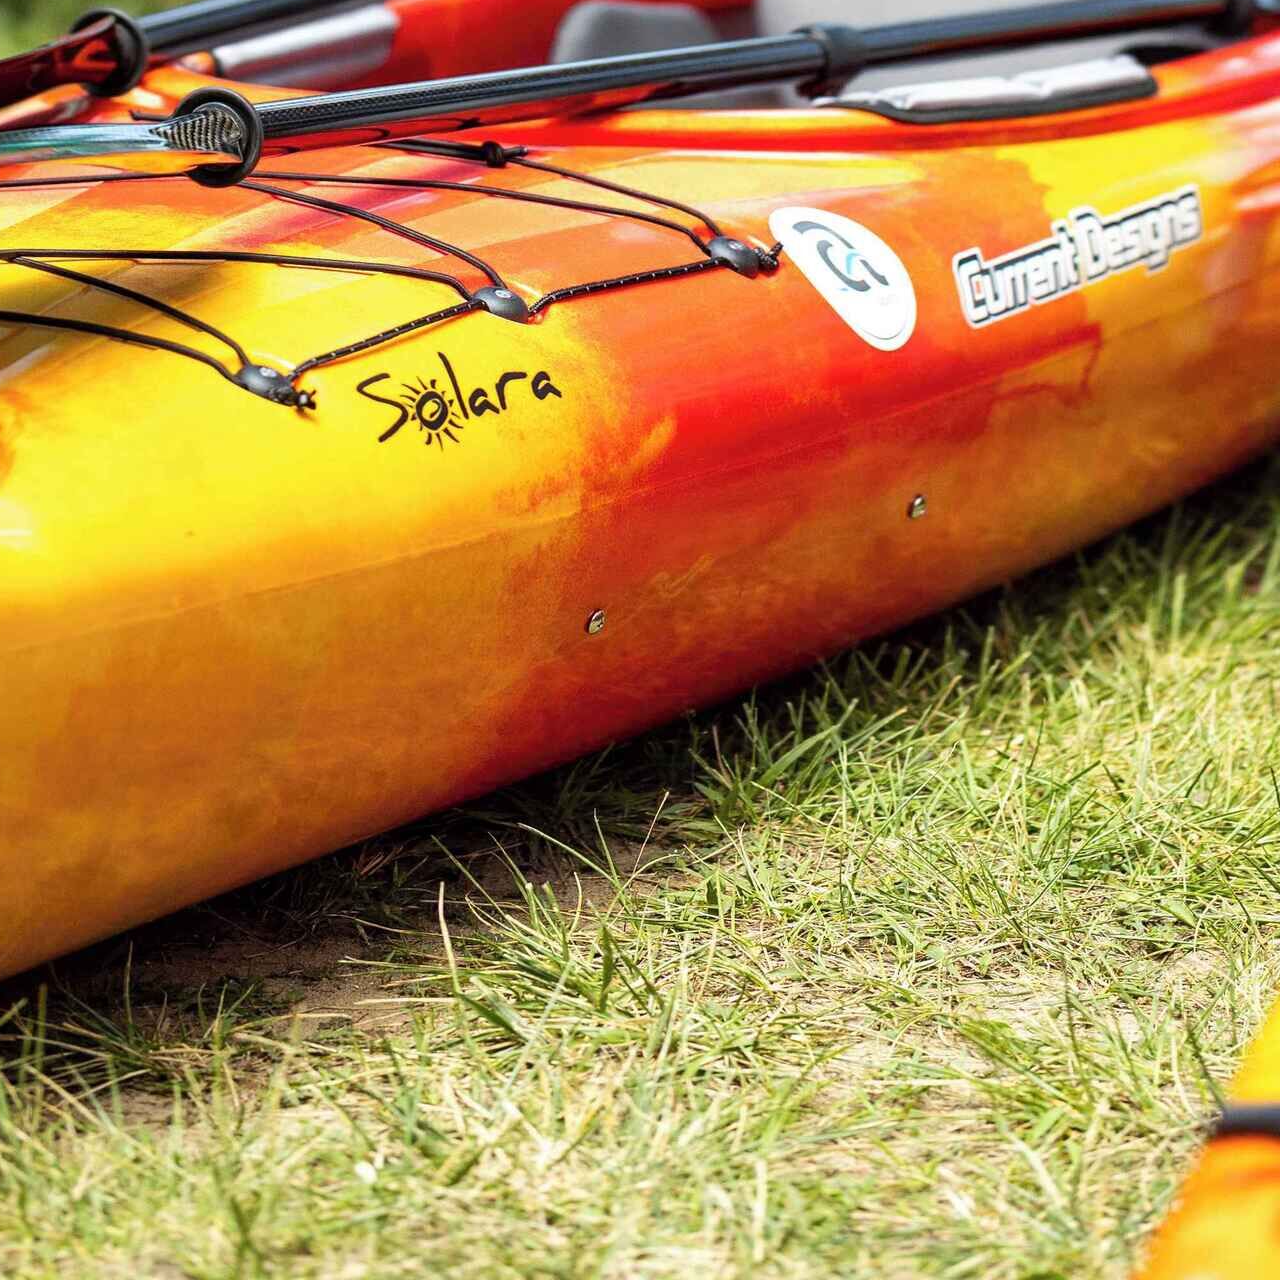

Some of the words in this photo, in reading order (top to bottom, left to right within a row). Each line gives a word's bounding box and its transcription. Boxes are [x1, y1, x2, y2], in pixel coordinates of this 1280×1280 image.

[955, 223, 1080, 326] Current
[1072, 188, 1202, 274] Designs
[356, 351, 563, 450] Solara
